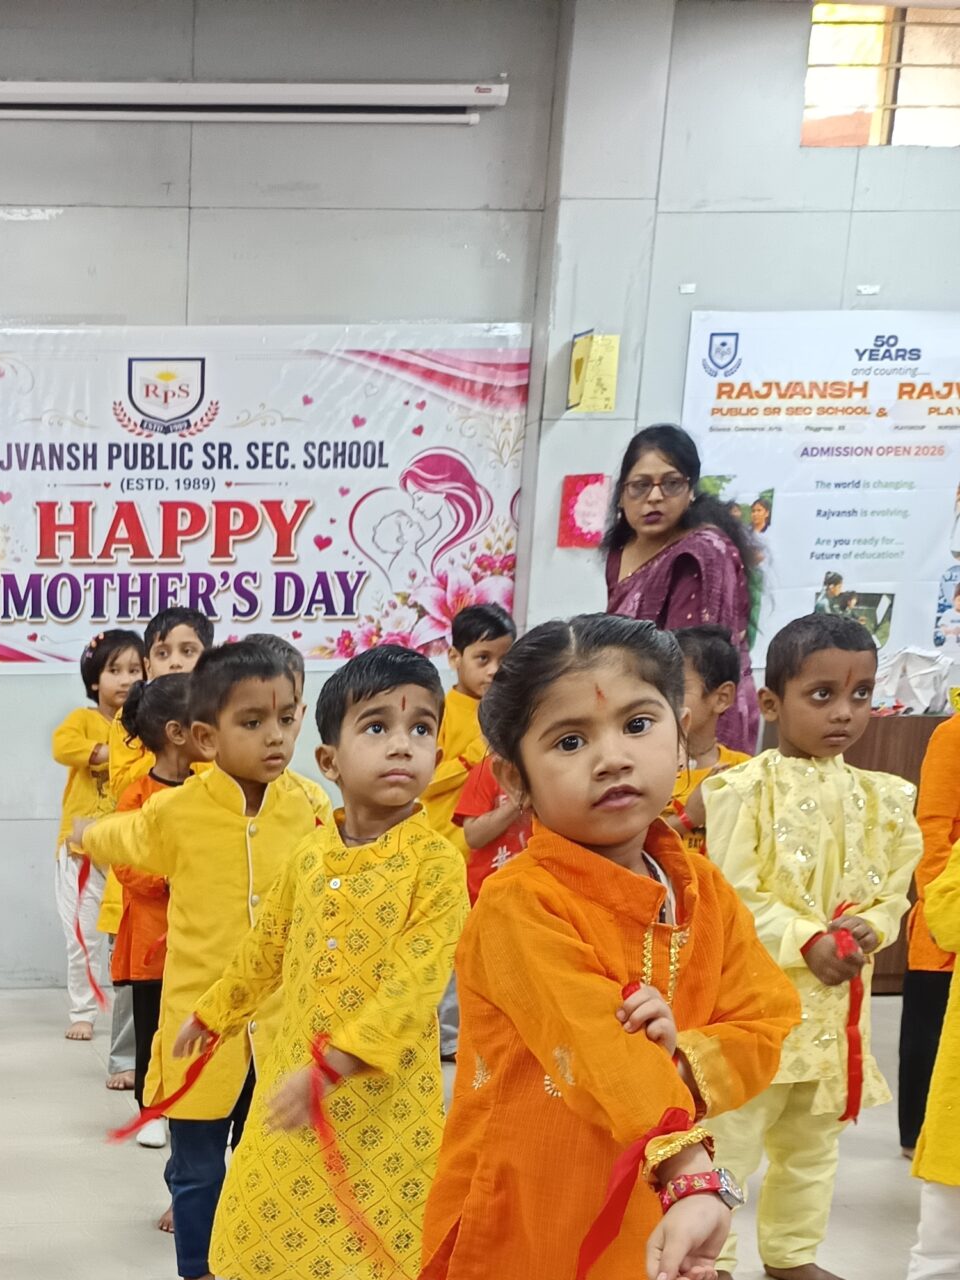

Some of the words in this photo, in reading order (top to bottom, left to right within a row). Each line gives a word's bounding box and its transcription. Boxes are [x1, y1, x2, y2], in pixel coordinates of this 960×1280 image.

[873, 335, 899, 348] 50
[854, 348, 922, 361] YEARS
[851, 366, 873, 376] and
[716, 381, 869, 400] RAJVANSH
[897, 382, 960, 400] RAJ
[710, 407, 759, 416] PUBLIC
[763, 406, 782, 416] SR
[785, 406, 813, 416] SEC
[816, 406, 871, 416] SCHOOL
[876, 407, 888, 418] &
[107, 442, 193, 471] PUBLIC
[202, 441, 239, 470] SR.
[246, 441, 295, 470] SEC.
[303, 440, 389, 470] SCHOOL
[800, 447, 873, 458] ADMISSION
[876, 446, 911, 457] OPEN
[914, 445, 945, 456] 2026
[120, 477, 169, 493] (ESTD.
[175, 476, 216, 493] 1989)
[815, 480, 831, 489] The
[834, 480, 861, 489] world
[863, 480, 871, 489] is
[816, 508, 858, 520] Rajvansh
[860, 508, 868, 517] is
[35, 500, 312, 562] HAPPY
[815, 537, 831, 546] Are
[833, 538, 850, 548] you
[852, 537, 879, 548] ready
[809, 551, 841, 561] Future
[842, 551, 852, 560] of
[854, 551, 905, 560] education?
[272, 570, 368, 619] DAY
